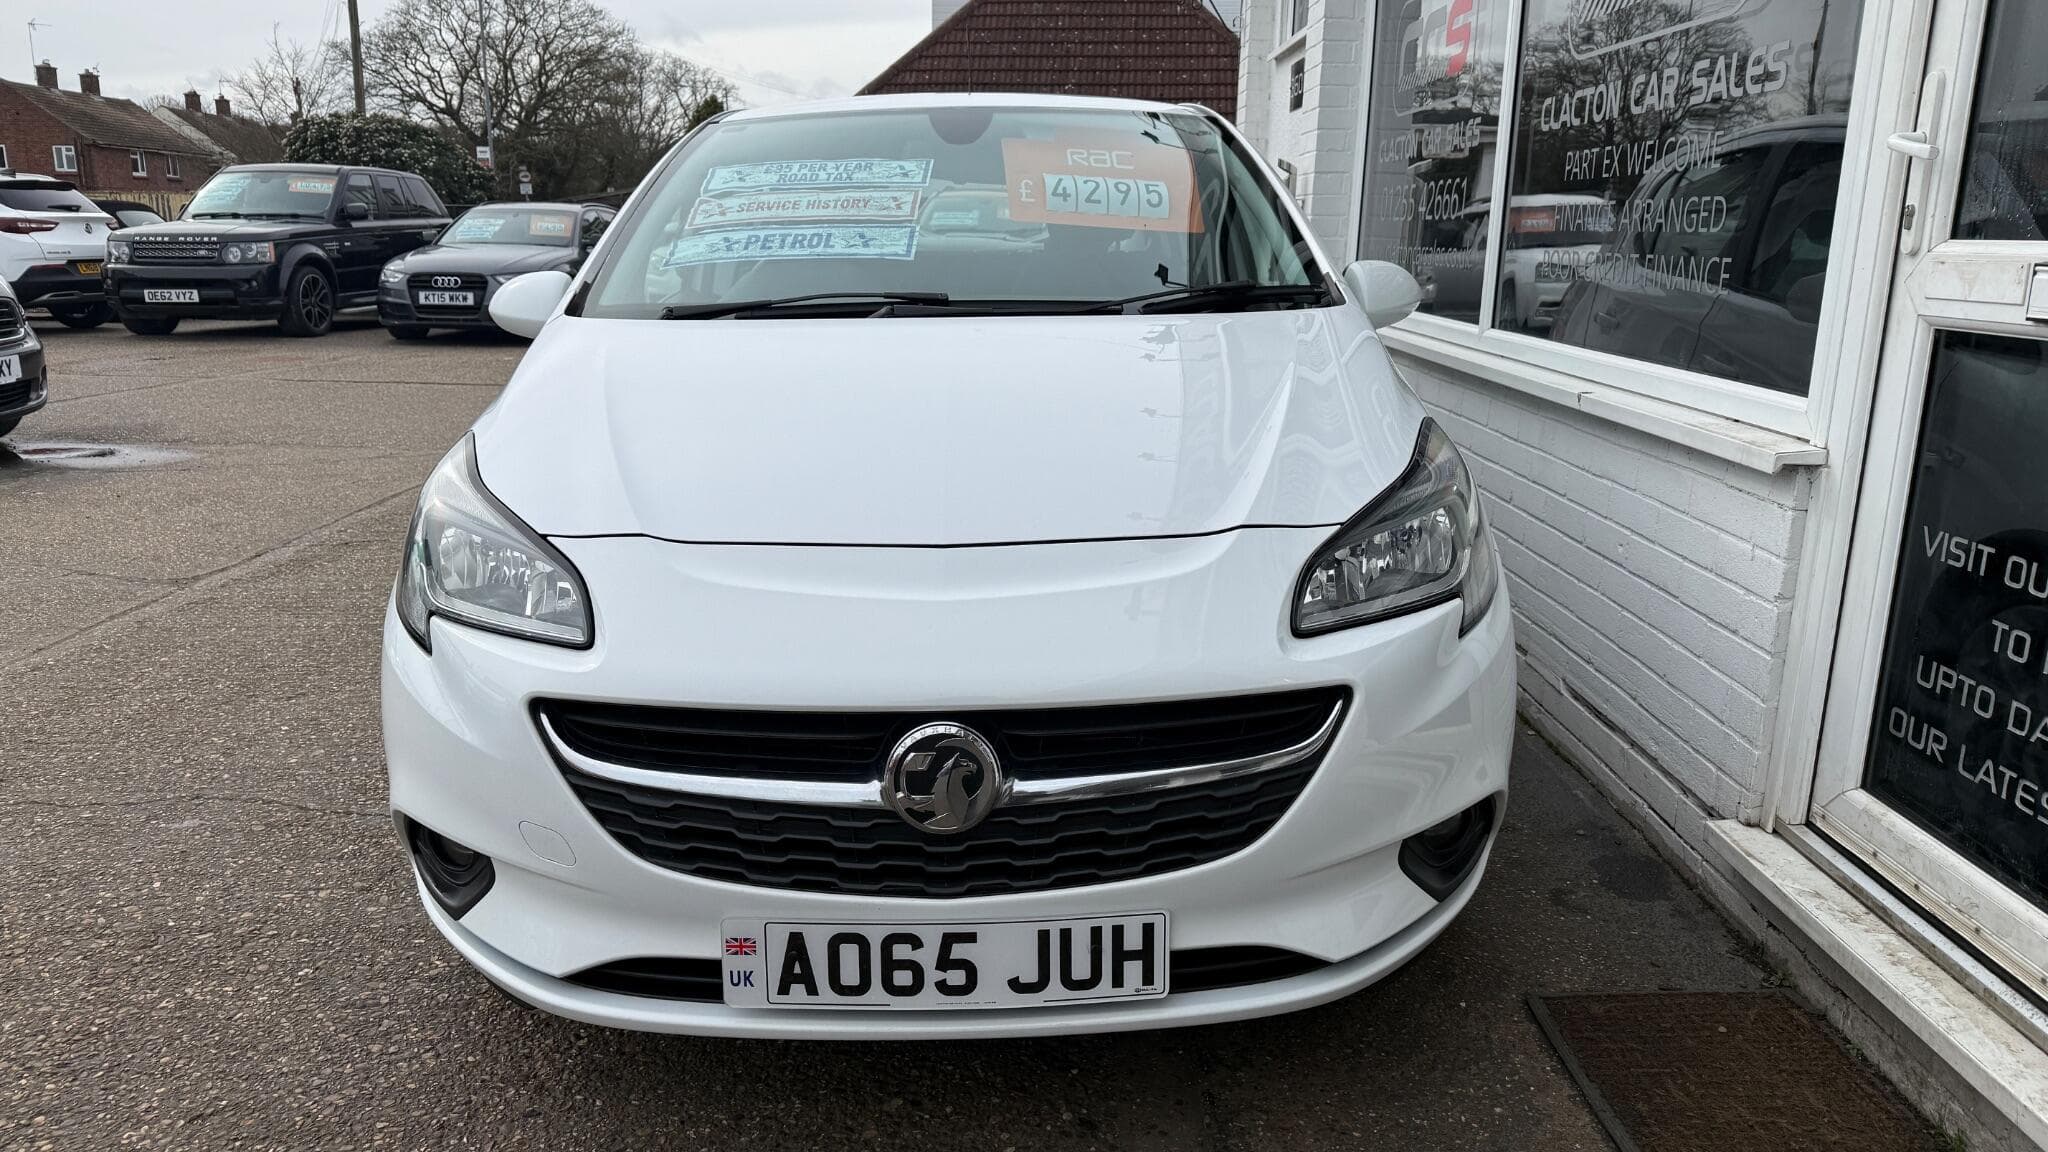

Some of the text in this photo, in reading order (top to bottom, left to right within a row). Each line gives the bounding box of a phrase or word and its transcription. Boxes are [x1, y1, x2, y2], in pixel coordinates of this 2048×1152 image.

[1541, 40, 1790, 132] CLACTON CAR SALES
[1379, 117, 1481, 162] CLACTON CAR SALES
[1564, 131, 1725, 181] PART EX WELCOME
[776, 172, 854, 183] ROAD TAX
[797, 163, 827, 173] PER
[833, 162, 874, 172] YEAR
[736, 198, 872, 213] SERVICE HISTORY
[1051, 178, 1163, 208] 4295
[1380, 177, 1468, 221] 01255 426661
[1552, 196, 1727, 233] FINANCE ARRANGED
[743, 233, 836, 251] PETROL
[1541, 251, 1732, 295] POOR CREDIT FINANCE
[147, 290, 195, 301] OE62 VYZ
[424, 293, 446, 303] KT15
[1924, 525, 1996, 577] VISIT
[1992, 619, 2031, 663] TO
[1916, 655, 1996, 719] UPTO
[1889, 707, 1948, 764] OUR
[729, 970, 755, 988] UK
[1007, 922, 1155, 994] JUH
